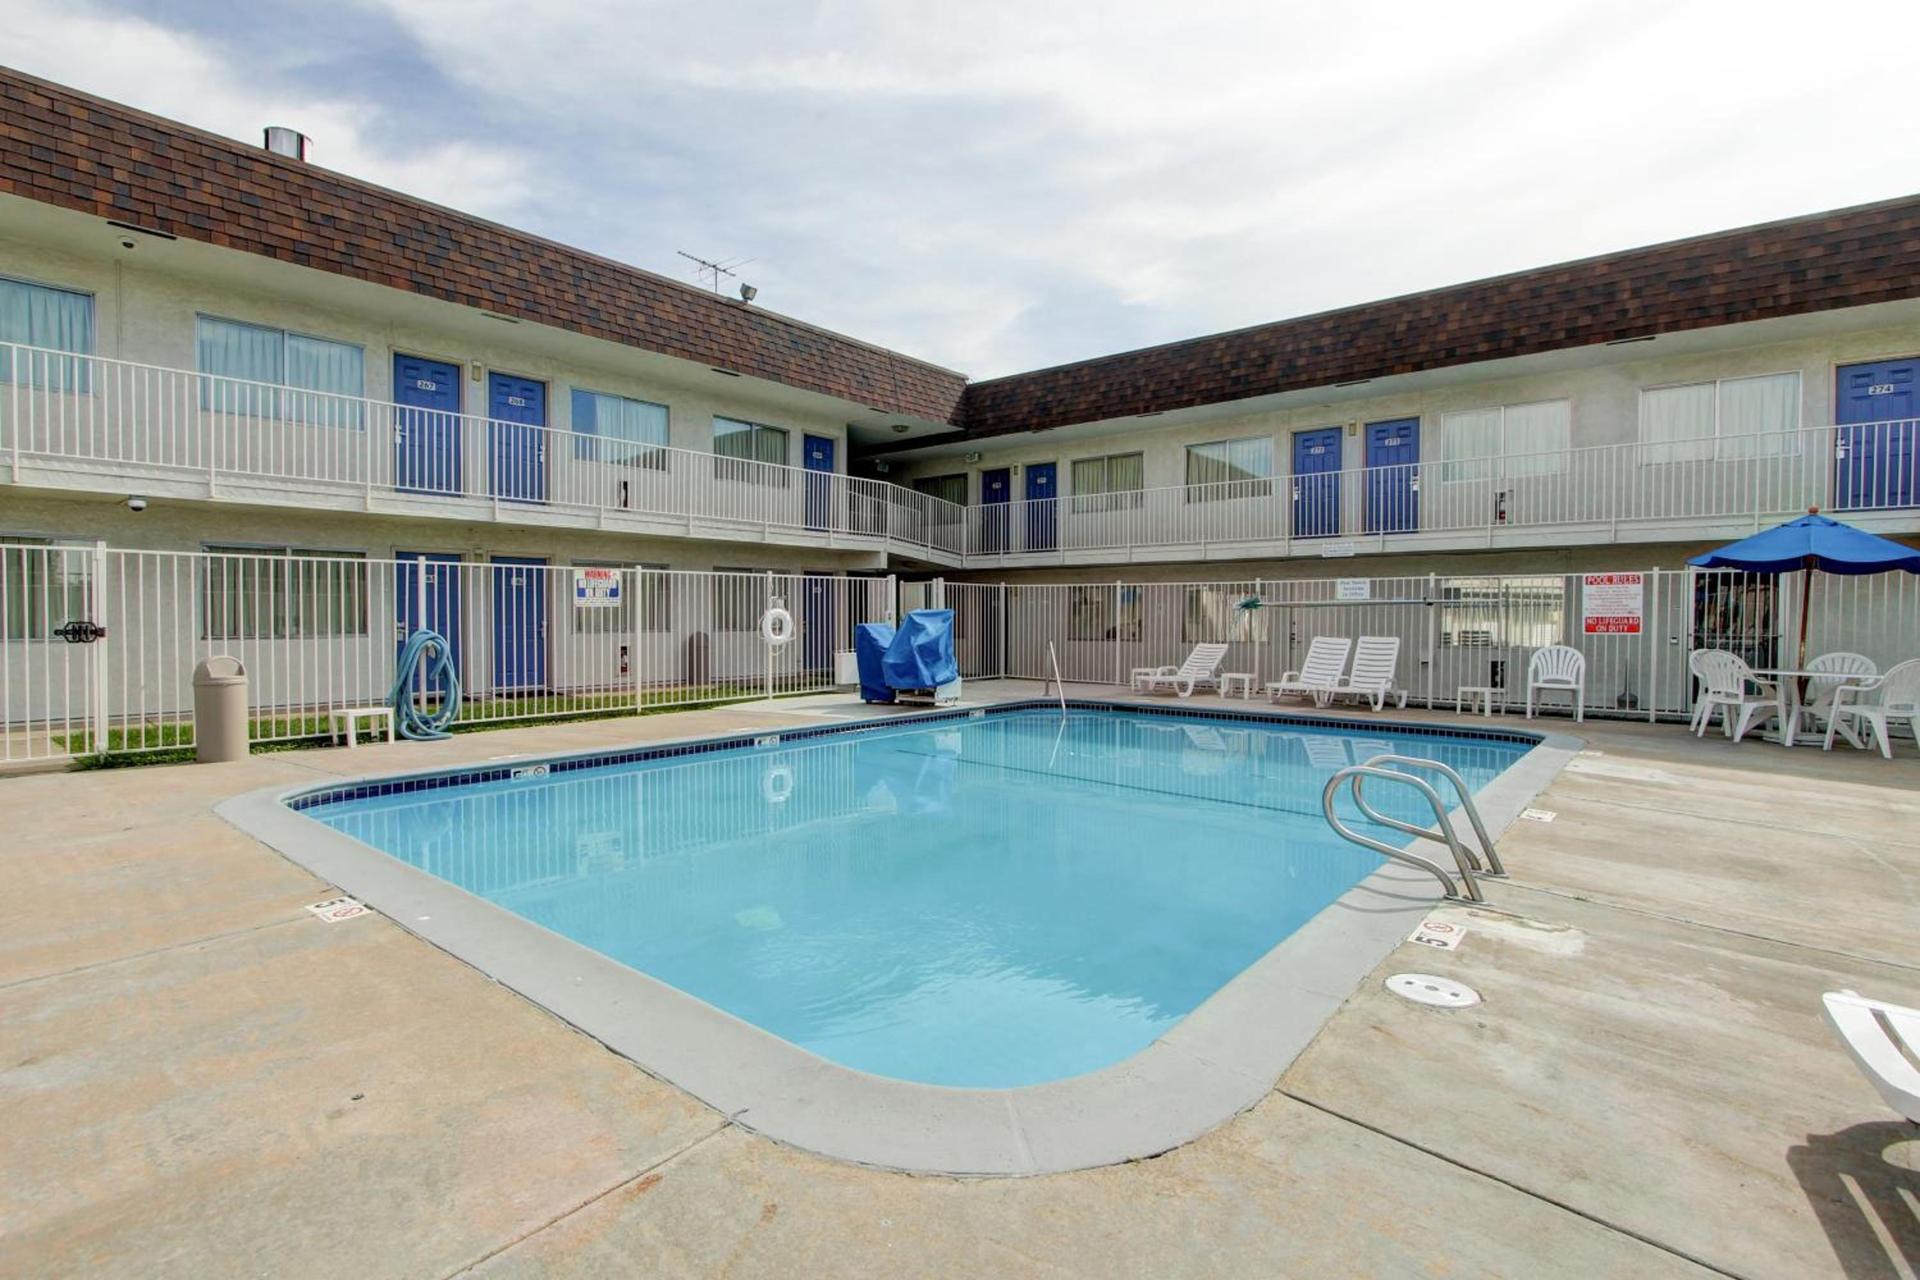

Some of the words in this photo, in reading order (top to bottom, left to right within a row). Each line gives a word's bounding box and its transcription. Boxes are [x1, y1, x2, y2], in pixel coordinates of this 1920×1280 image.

[1870, 385, 1892, 394] 274
[1587, 575, 1611, 585] POOL
[1613, 574, 1639, 584] RULES
[1587, 617, 1597, 625] NO
[1599, 617, 1639, 625] LIFEGUARD
